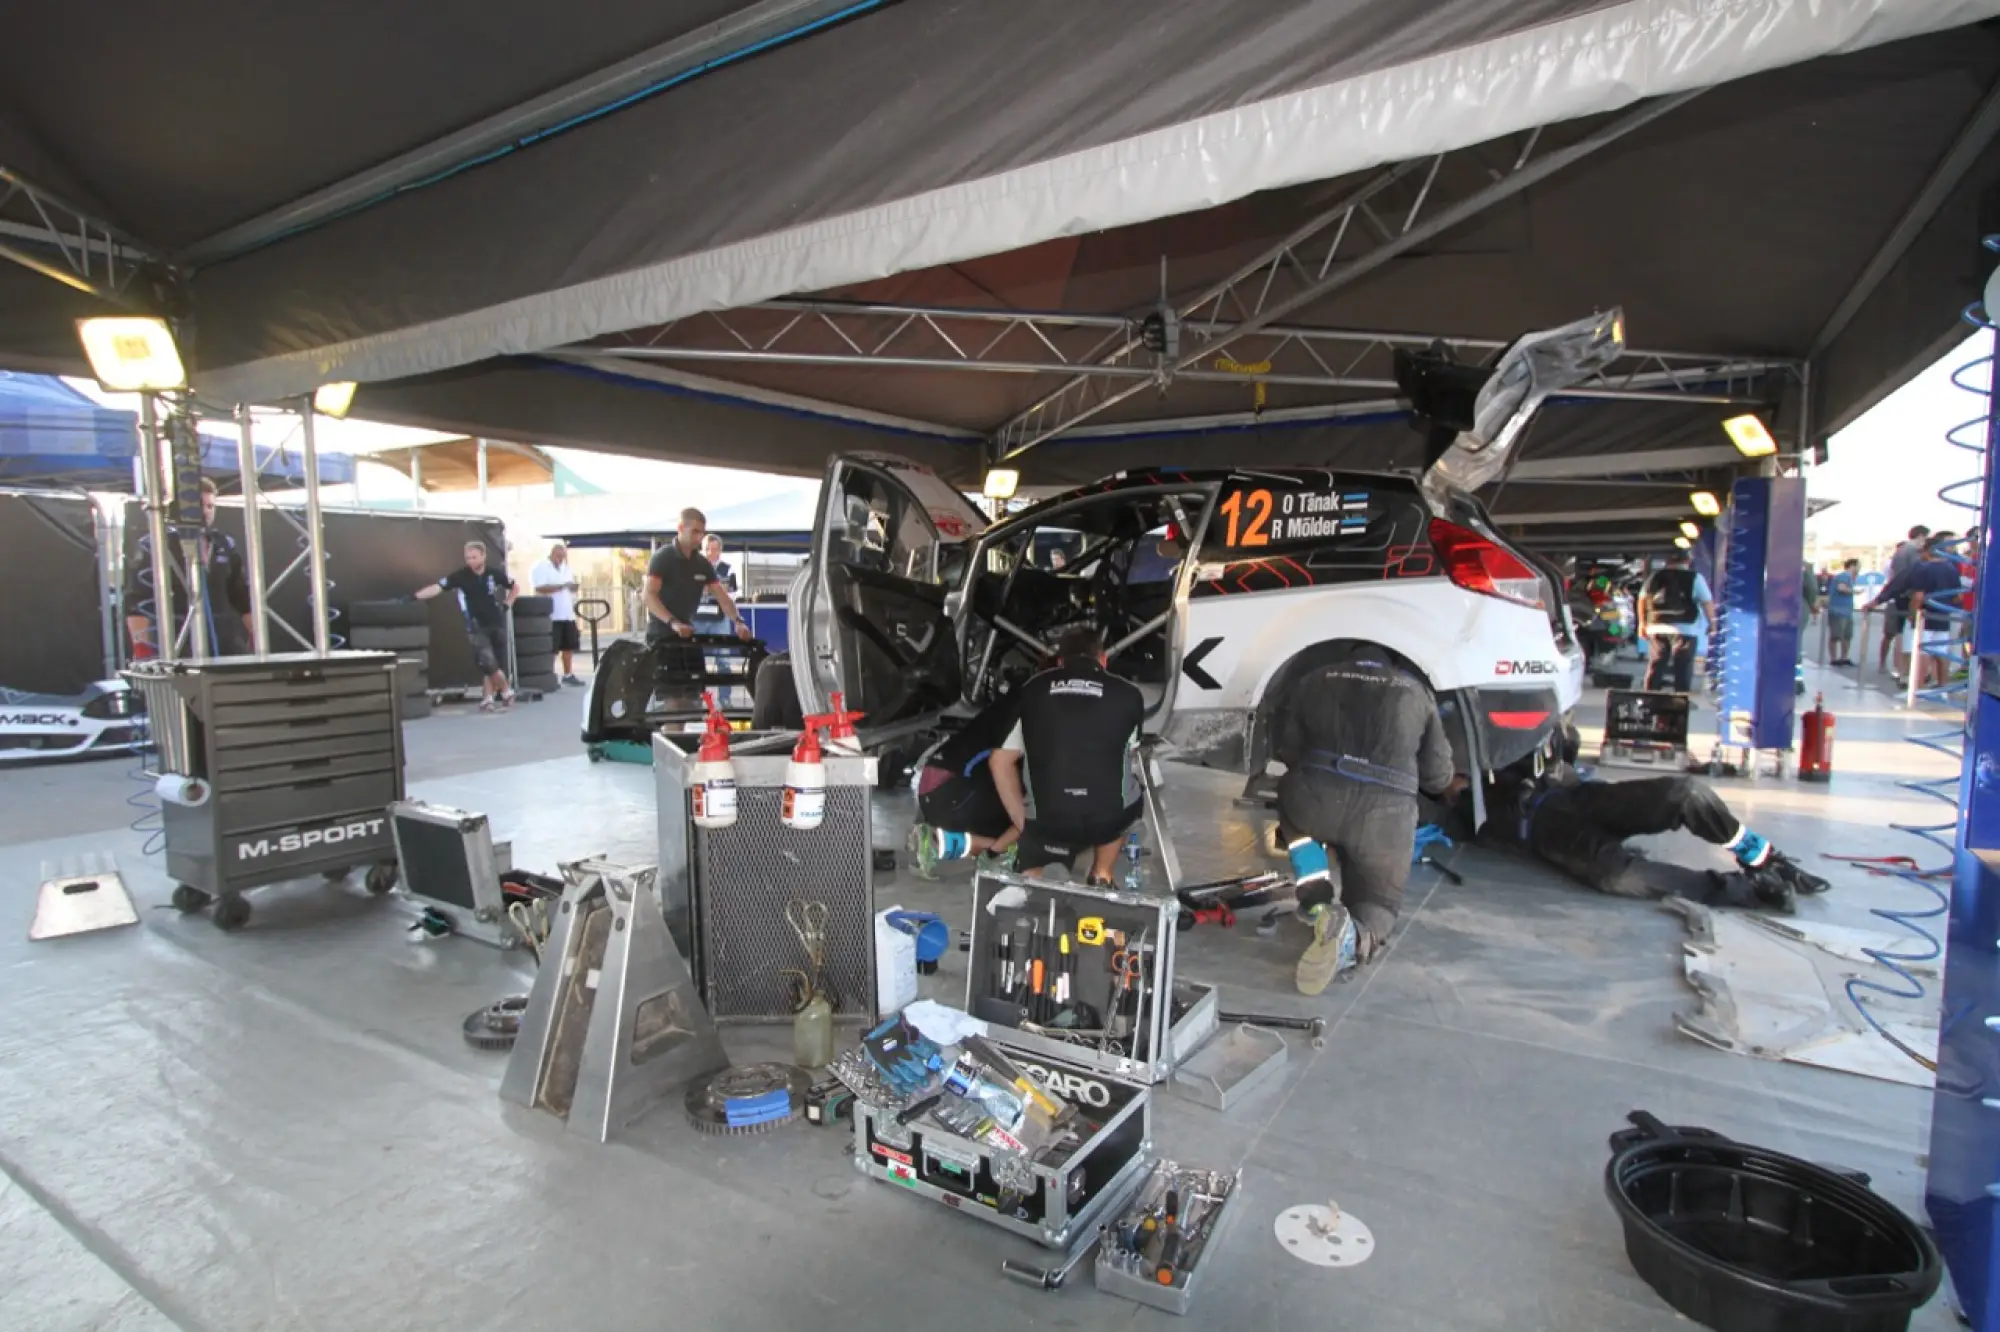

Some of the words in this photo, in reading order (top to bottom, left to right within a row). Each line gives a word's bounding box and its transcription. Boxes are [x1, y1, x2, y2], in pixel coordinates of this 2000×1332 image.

[1220, 488, 1273, 548] 12
[1271, 519, 1283, 539] R
[238, 818, 385, 860] M-SPORT
